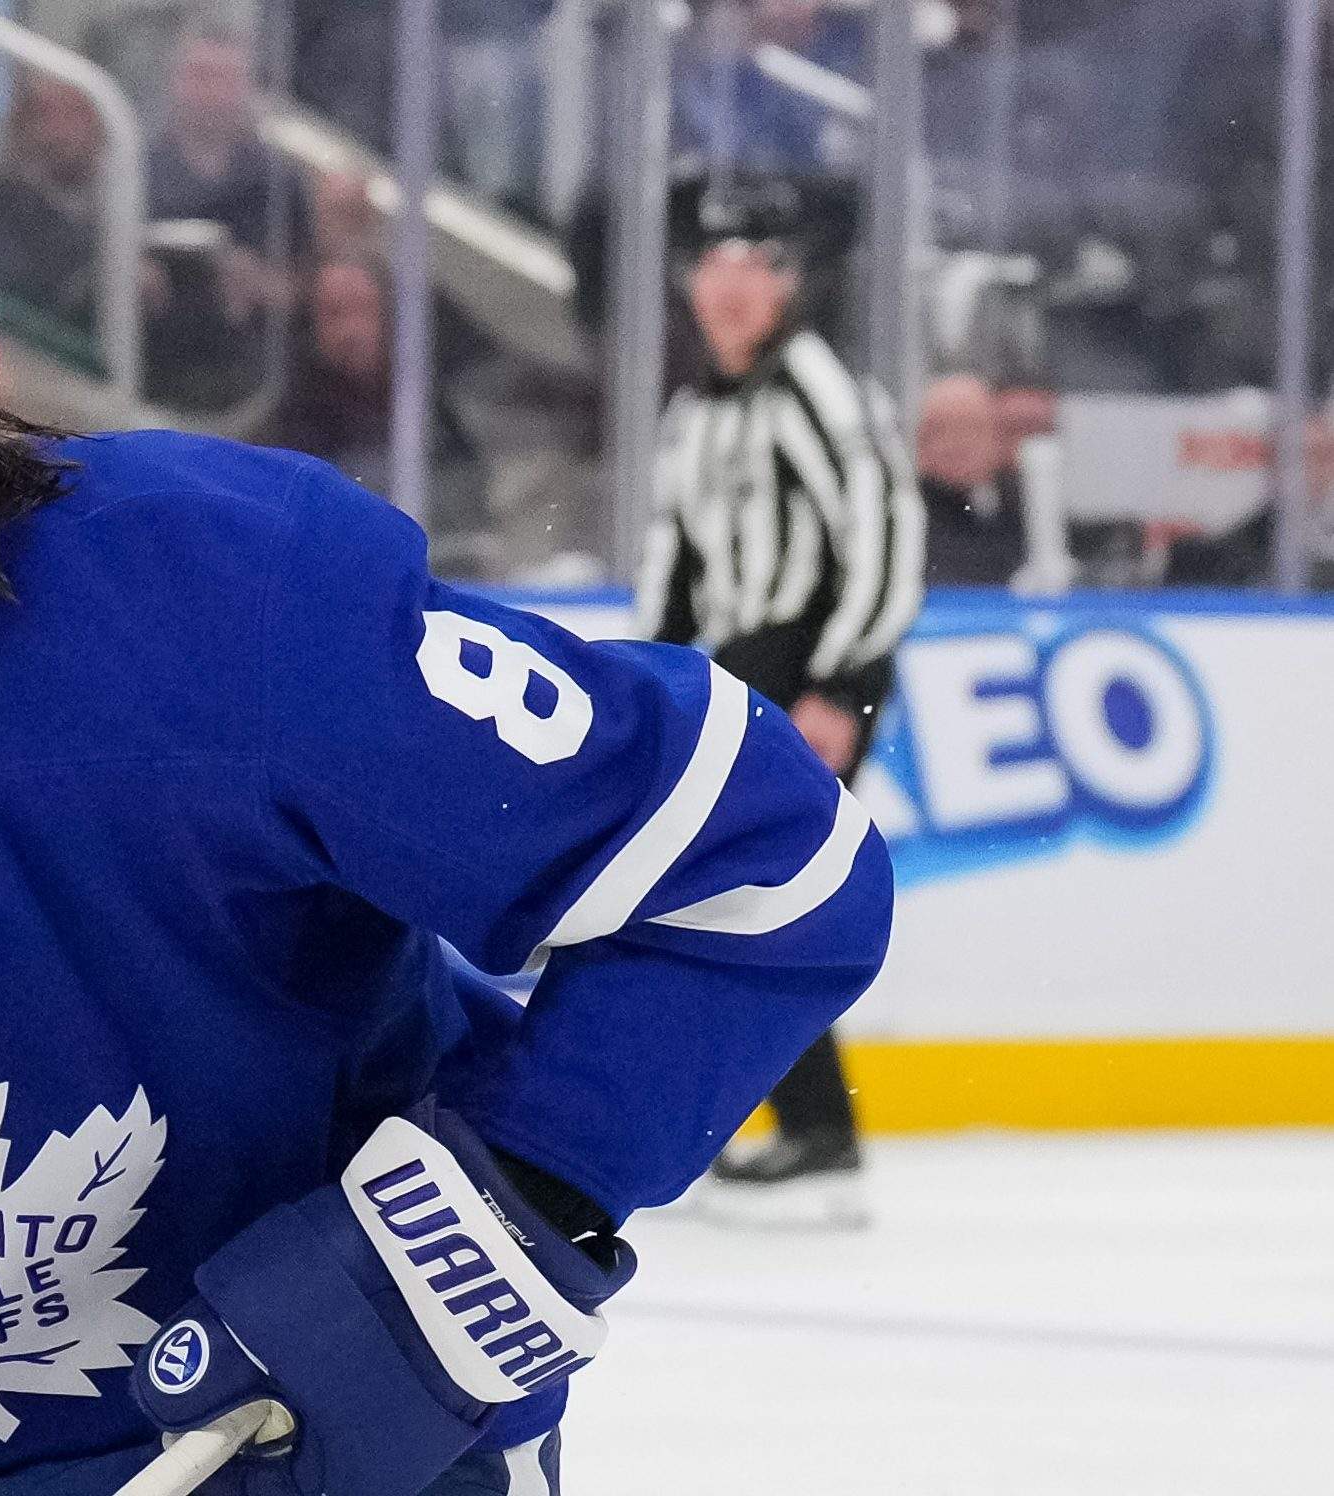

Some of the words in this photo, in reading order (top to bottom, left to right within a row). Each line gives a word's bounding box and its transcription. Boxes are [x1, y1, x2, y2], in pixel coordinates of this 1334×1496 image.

[416, 610, 594, 765] 8
[854, 632, 1204, 836] EO
[360, 1158, 593, 1392] WARRI
